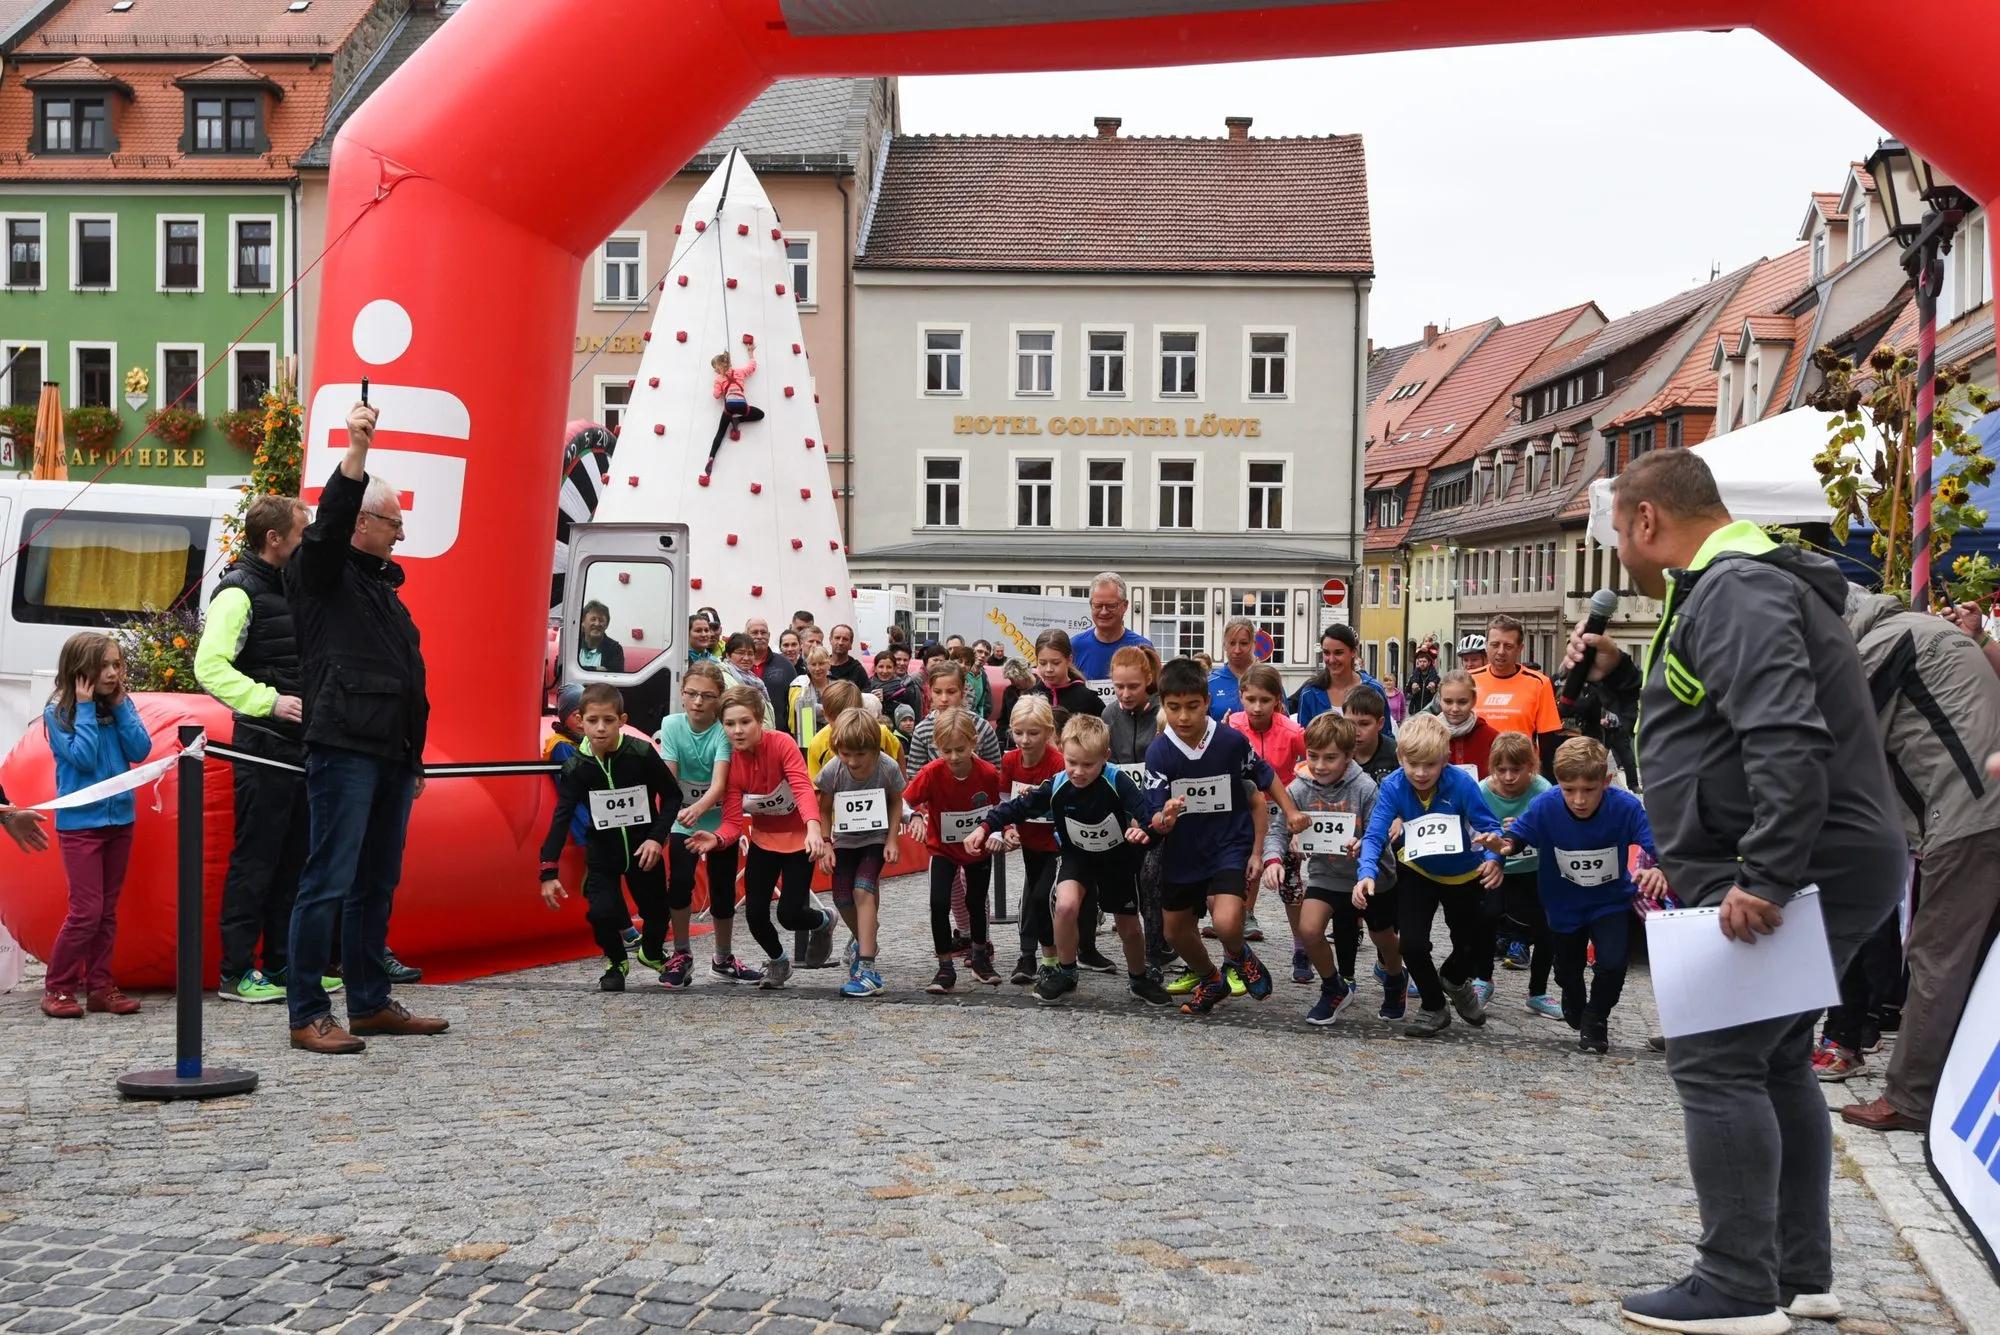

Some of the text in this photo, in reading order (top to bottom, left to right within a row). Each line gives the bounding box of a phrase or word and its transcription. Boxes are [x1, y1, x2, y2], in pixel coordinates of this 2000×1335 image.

[574, 337, 645, 354] DNER
[953, 413, 1262, 437] HOTEL GOLDNER LÖWE
[584, 432, 590, 447] 5
[597, 430, 609, 446] 20
[72, 448, 205, 467] APOTHEKE
[1186, 786, 1216, 796] 061
[606, 797, 634, 810] 041
[757, 795, 784, 809] 305
[846, 800, 873, 812] 057
[1080, 829, 1109, 839] 026
[1313, 822, 1344, 834] 034
[1417, 823, 1447, 838] 029
[1570, 859, 1603, 870] 039
